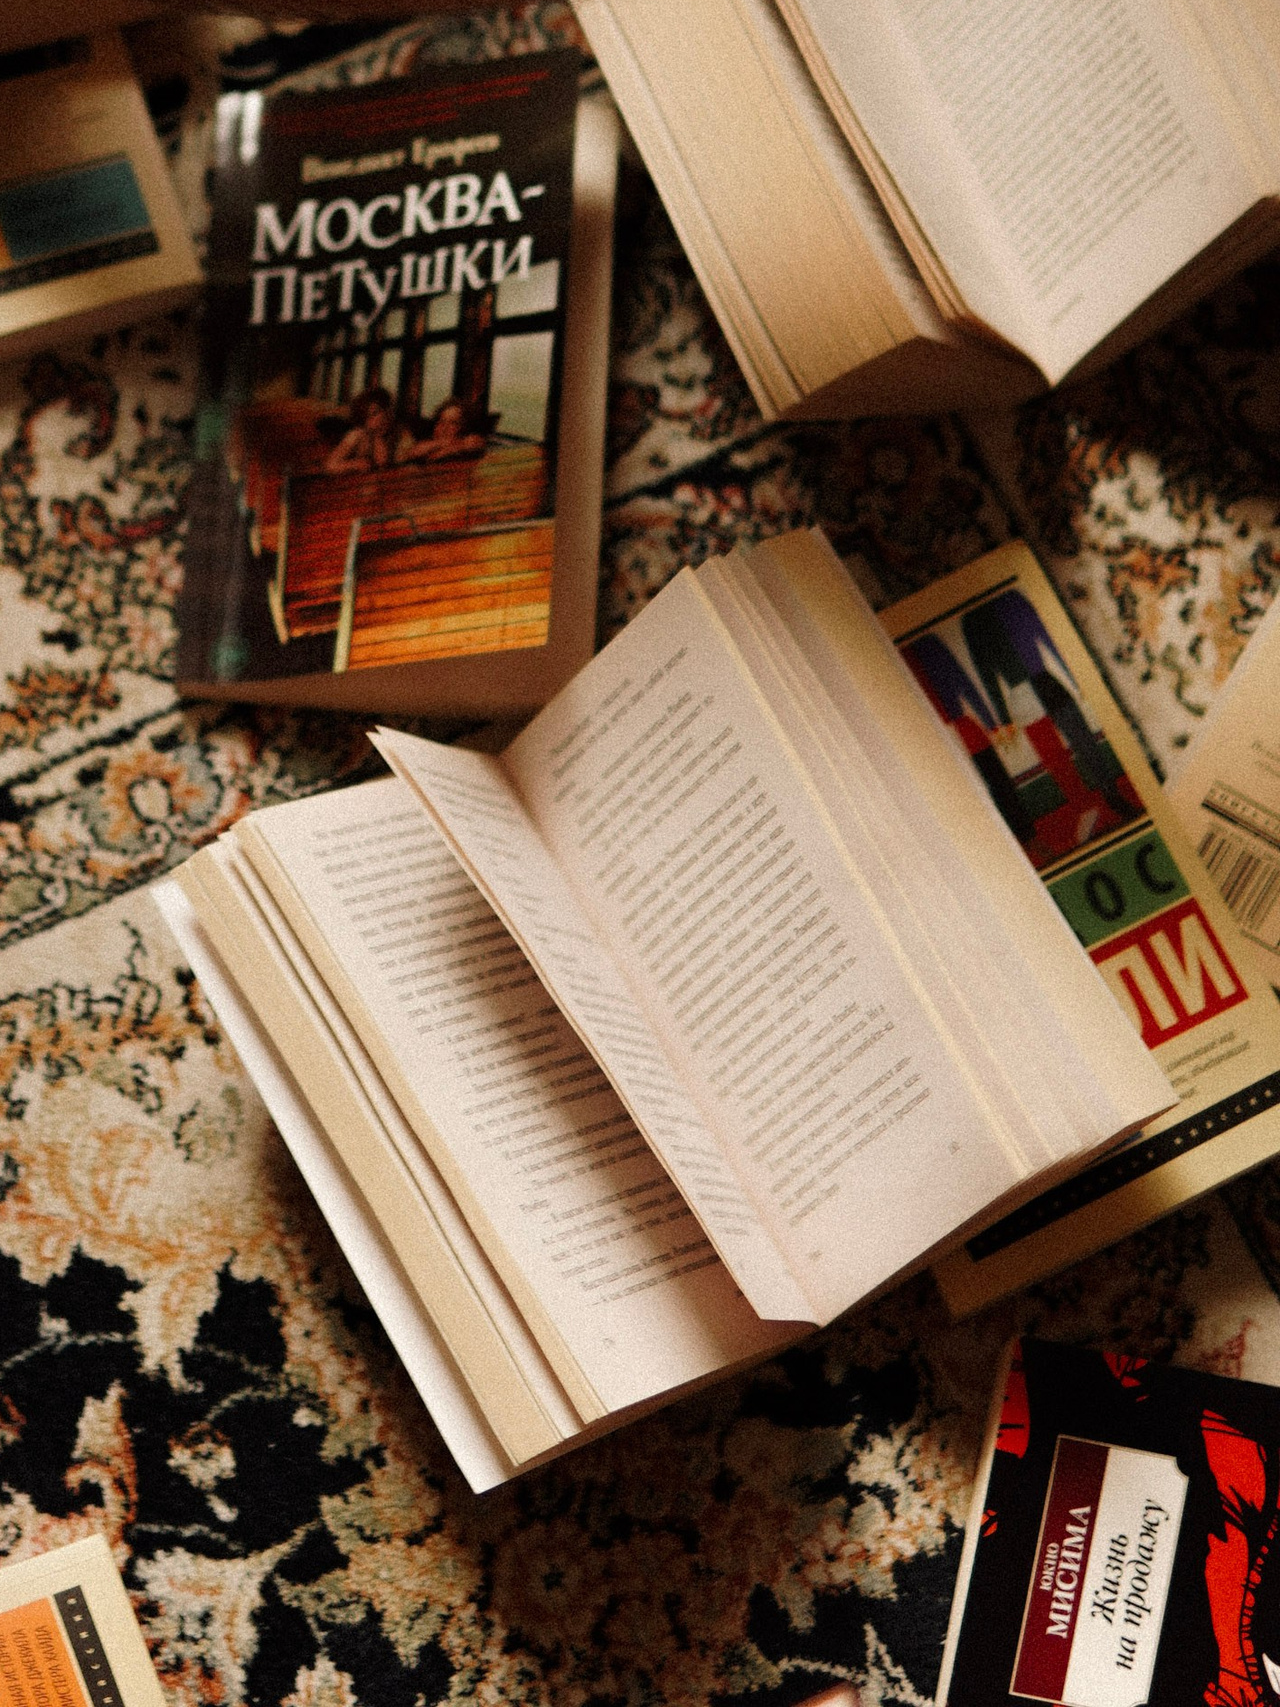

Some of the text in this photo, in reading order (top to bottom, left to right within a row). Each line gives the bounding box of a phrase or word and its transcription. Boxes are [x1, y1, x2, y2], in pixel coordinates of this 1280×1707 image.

[251, 168, 547, 263] МОСКВА-
[248, 234, 535, 329] ПЕТУШКИ
[1039, 1542, 1060, 1592] ЮКИО
[1045, 1505, 1092, 1639] МИСИМА
[1091, 1533, 1129, 1625] Жизнь
[1116, 1498, 1170, 1671] на продажу
[12, 1628, 45, 1680] ДЖЕКИЛА
[34, 1625, 58, 1663] ХАЙДА
